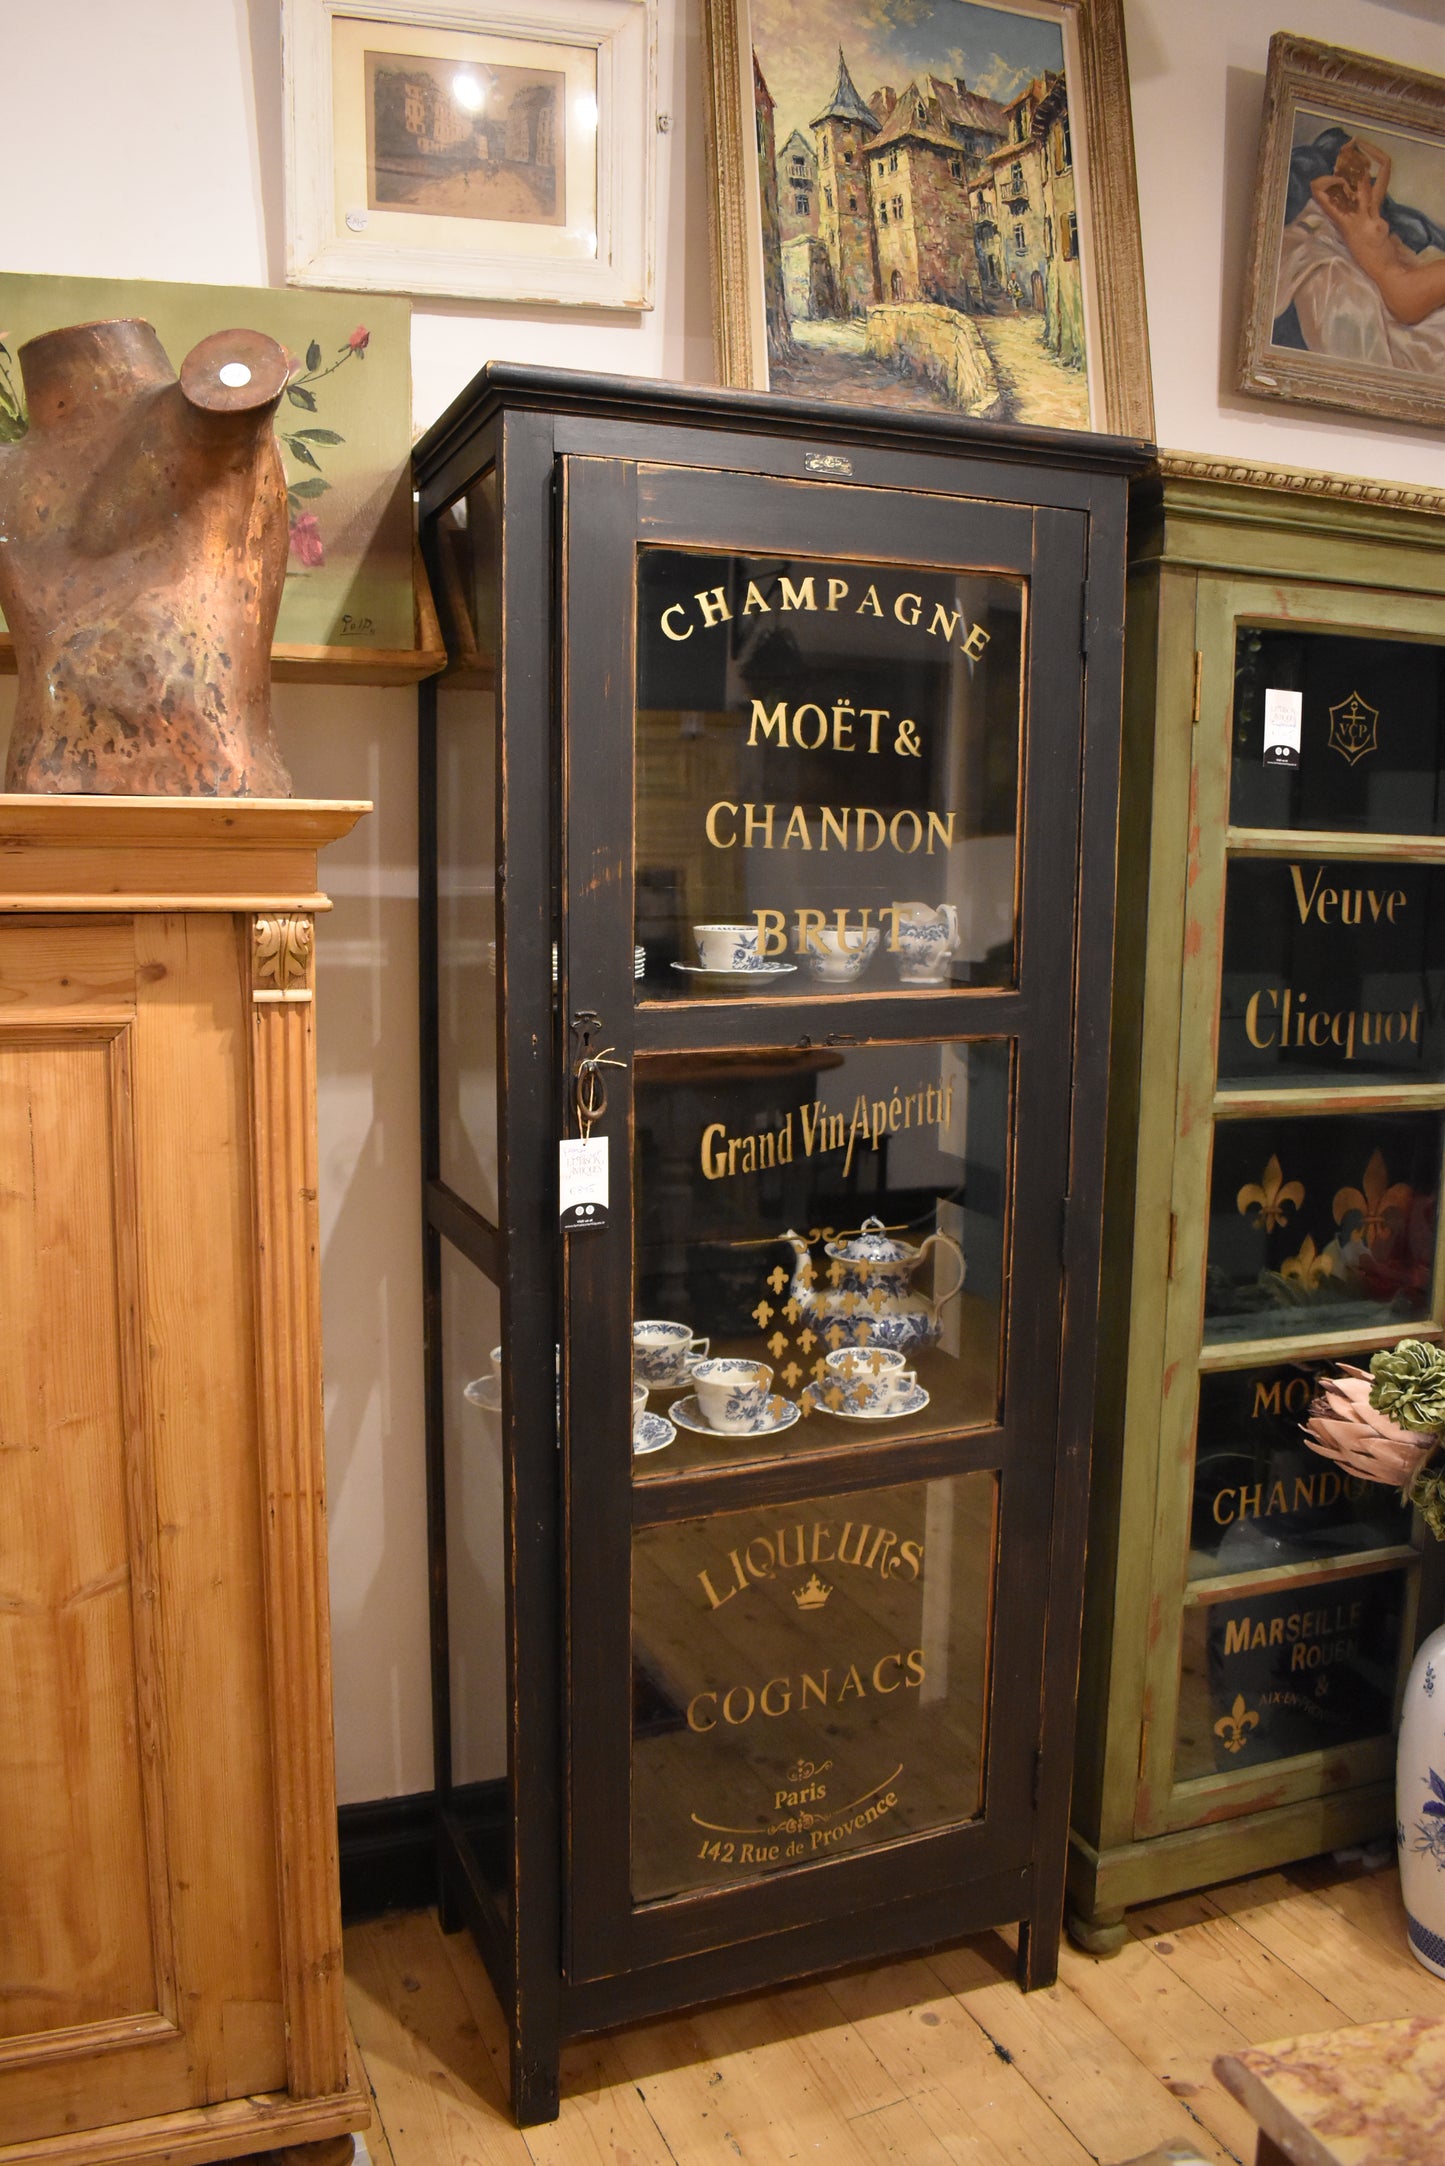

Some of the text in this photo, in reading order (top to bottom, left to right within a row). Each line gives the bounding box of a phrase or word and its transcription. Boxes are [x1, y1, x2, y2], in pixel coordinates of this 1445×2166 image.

[660, 577, 991, 661] CHAMPAGNE
[747, 699, 922, 758] MOËT &
[705, 801, 957, 855] CHANDON
[1288, 864, 1407, 926] Veuve
[752, 907, 914, 957] BRUT
[1245, 988, 1421, 1059] Clicquot
[701, 1073, 956, 1180] Grand Vin Apéritif
[1213, 1472, 1375, 1525] CHANDO
[697, 1520, 925, 1610] LIQUEURS
[1223, 1602, 1362, 1656] MARSEILLE
[686, 1649, 927, 1733] COGNACS
[774, 1782, 827, 1809] Paris
[697, 1791, 898, 1864] 142 Rue de Provence
